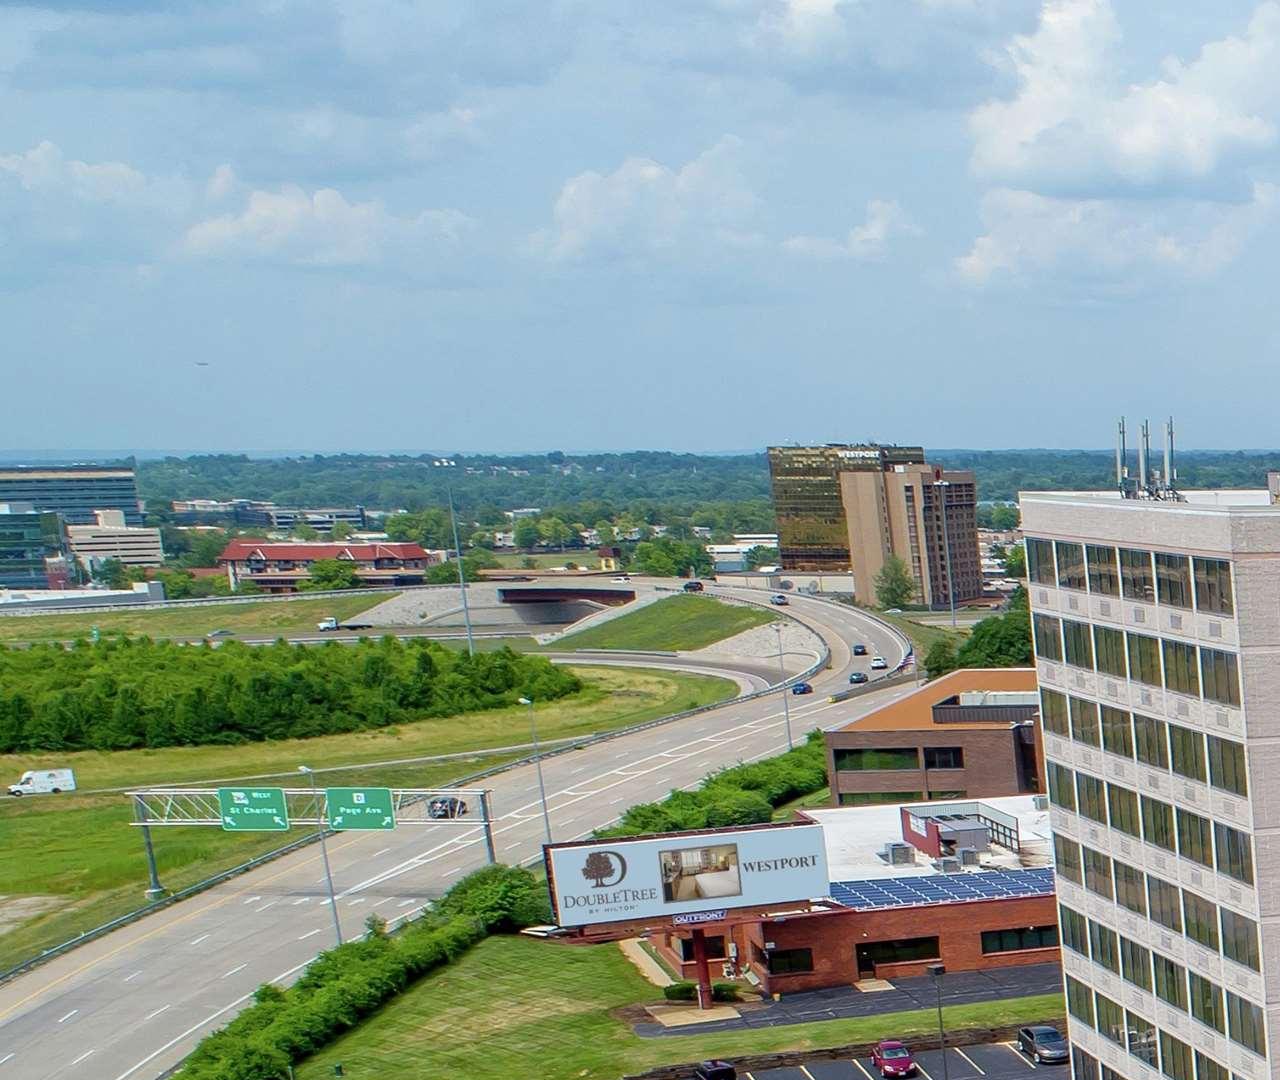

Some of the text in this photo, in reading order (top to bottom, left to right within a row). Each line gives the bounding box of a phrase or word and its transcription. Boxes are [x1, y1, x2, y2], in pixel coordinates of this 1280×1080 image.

[837, 450, 880, 458] WESTPORT
[243, 806, 277, 815] Charles
[339, 806, 383, 815] Page Ave
[743, 854, 819, 873] WESTPORT
[604, 904, 637, 913] HILTON
[675, 909, 726, 923] OUTFRONT
